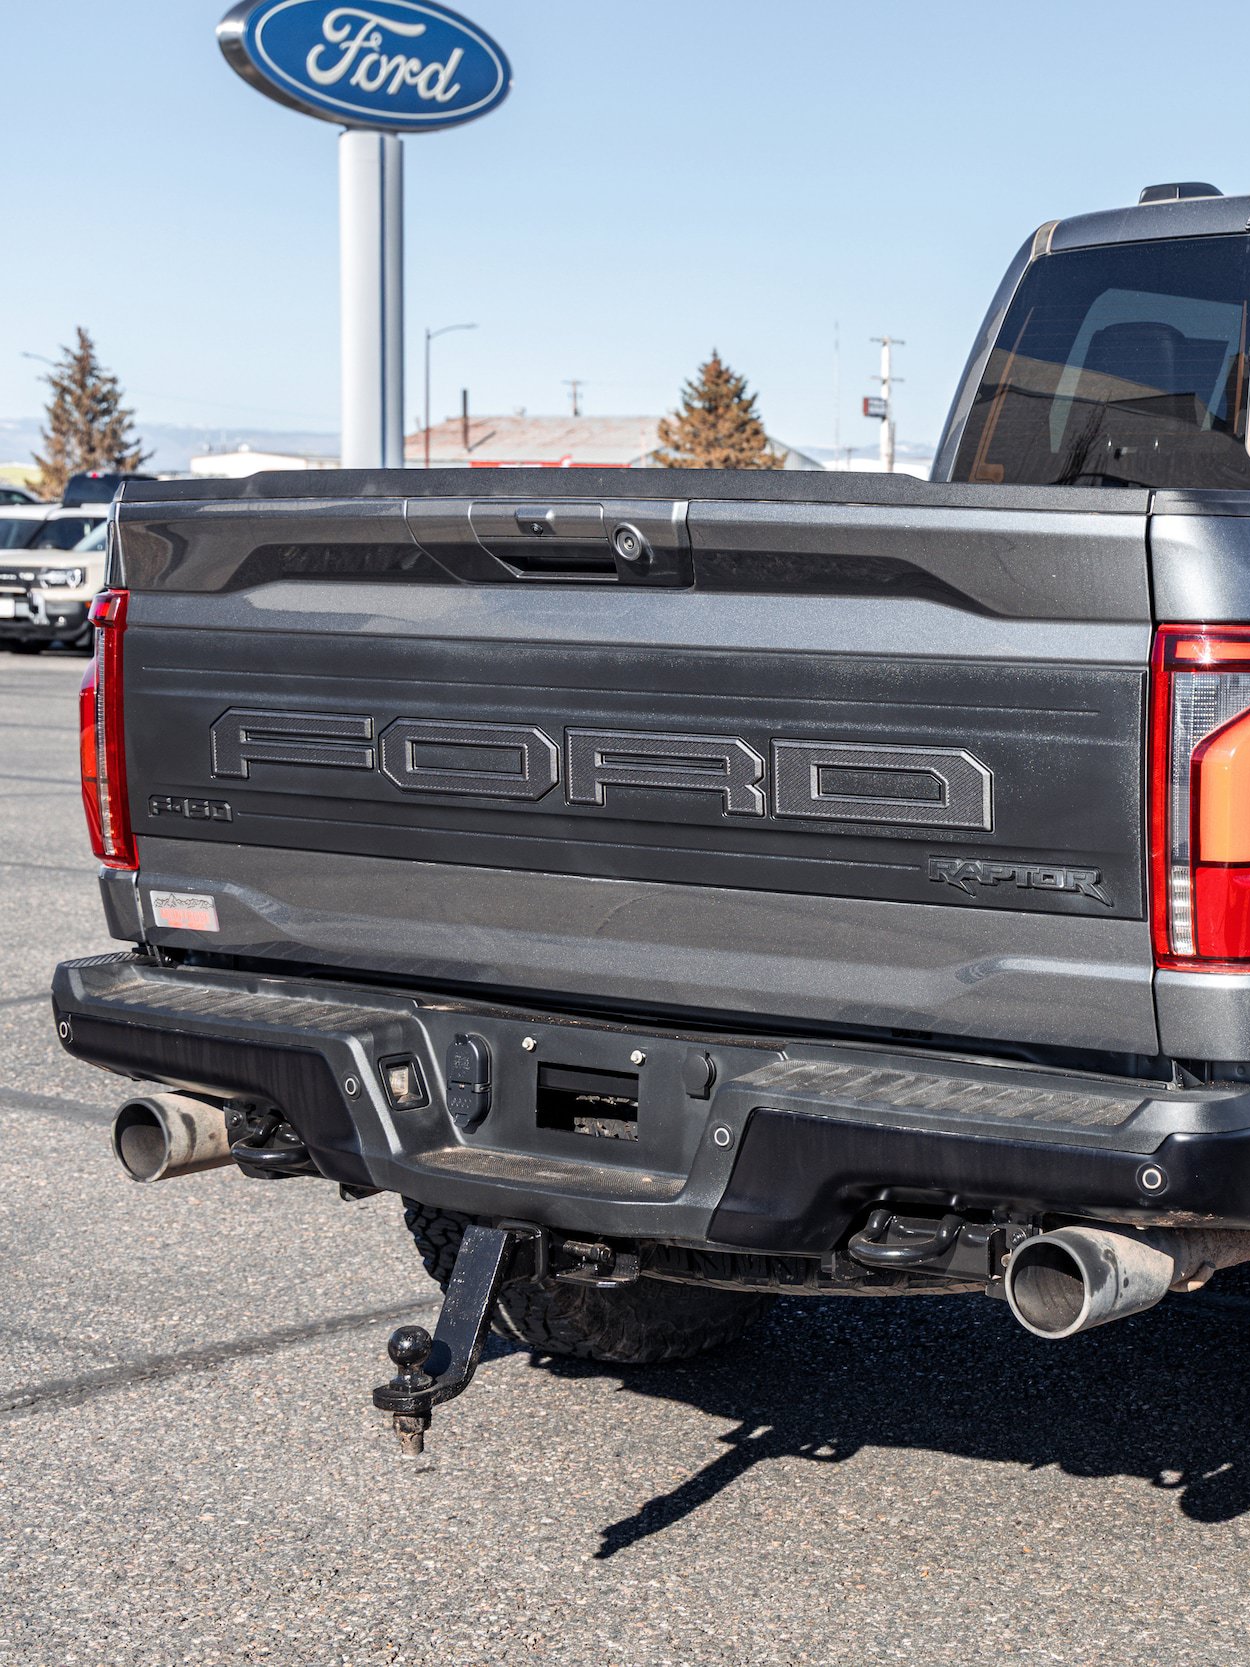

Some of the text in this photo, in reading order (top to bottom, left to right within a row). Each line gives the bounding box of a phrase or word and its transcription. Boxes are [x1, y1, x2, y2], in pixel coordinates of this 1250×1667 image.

[305, 7, 464, 104] Ford
[210, 706, 995, 833] FORD
[148, 794, 233, 822] F-150
[928, 854, 1114, 908] RAPTOR
